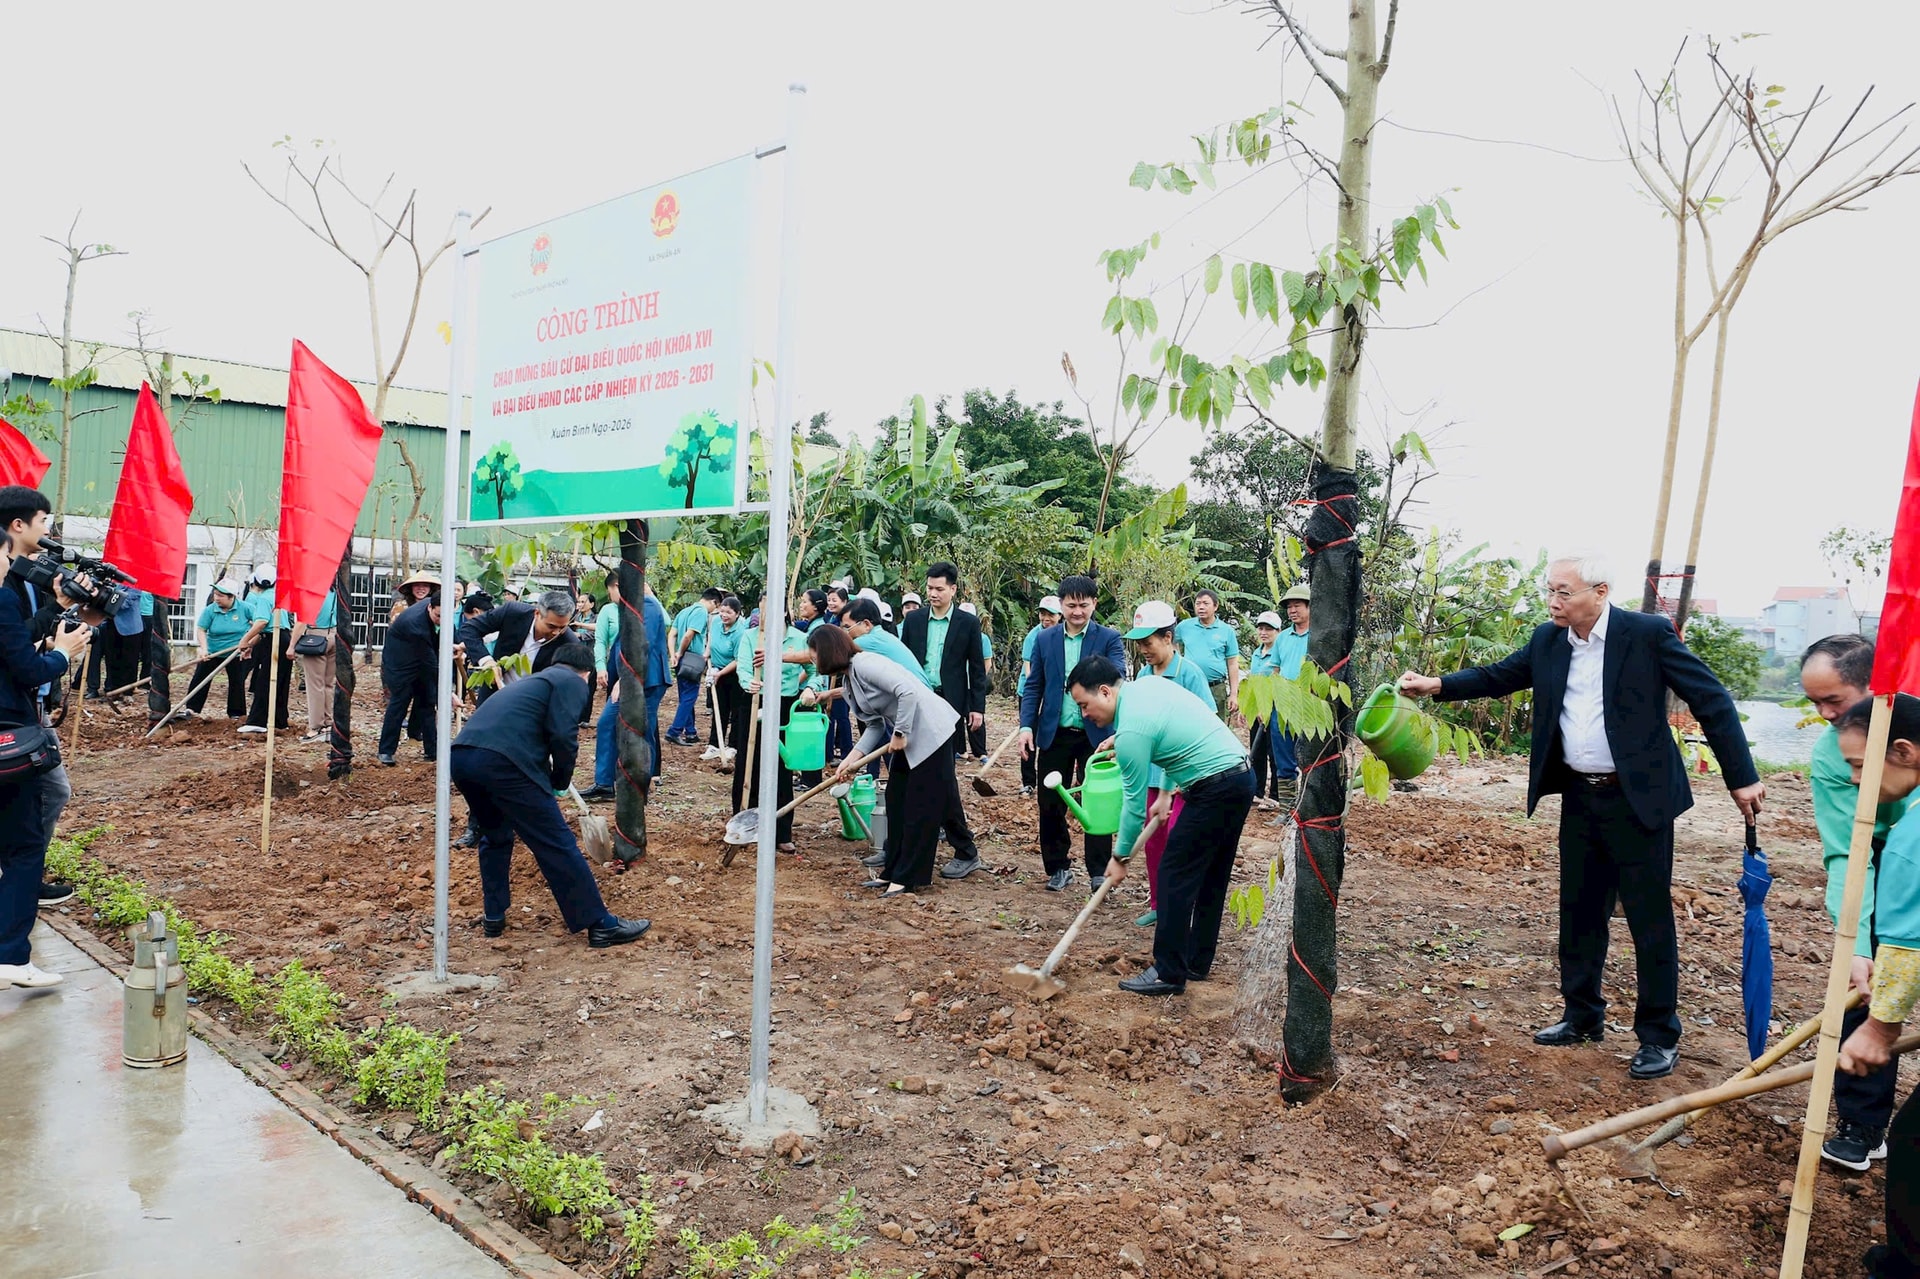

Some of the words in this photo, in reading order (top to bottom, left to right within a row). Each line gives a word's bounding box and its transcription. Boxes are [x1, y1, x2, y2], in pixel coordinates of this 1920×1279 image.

[537, 307, 588, 342] CÔNG
[594, 291, 660, 330] TRÌNH
[560, 351, 573, 375] CỬ
[575, 354, 590, 375] ĐẠI
[593, 344, 614, 369] BIỂU
[617, 338, 643, 366] QUỐC
[645, 337, 662, 362] HỘI
[665, 331, 692, 356] KHÓA
[695, 328, 712, 350] XVI
[503, 397, 516, 417] ĐẠI
[518, 387, 536, 412] BIỂU
[538, 389, 562, 408] HĐND
[564, 384, 582, 404] CÁC
[584, 378, 603, 401] CẤP
[605, 375, 637, 399] NHIỆM
[655, 369, 680, 391] 2026
[689, 363, 714, 384] 2031
[551, 427, 571, 439] Xuân
[591, 418, 632, 436] Ngọ-2026
